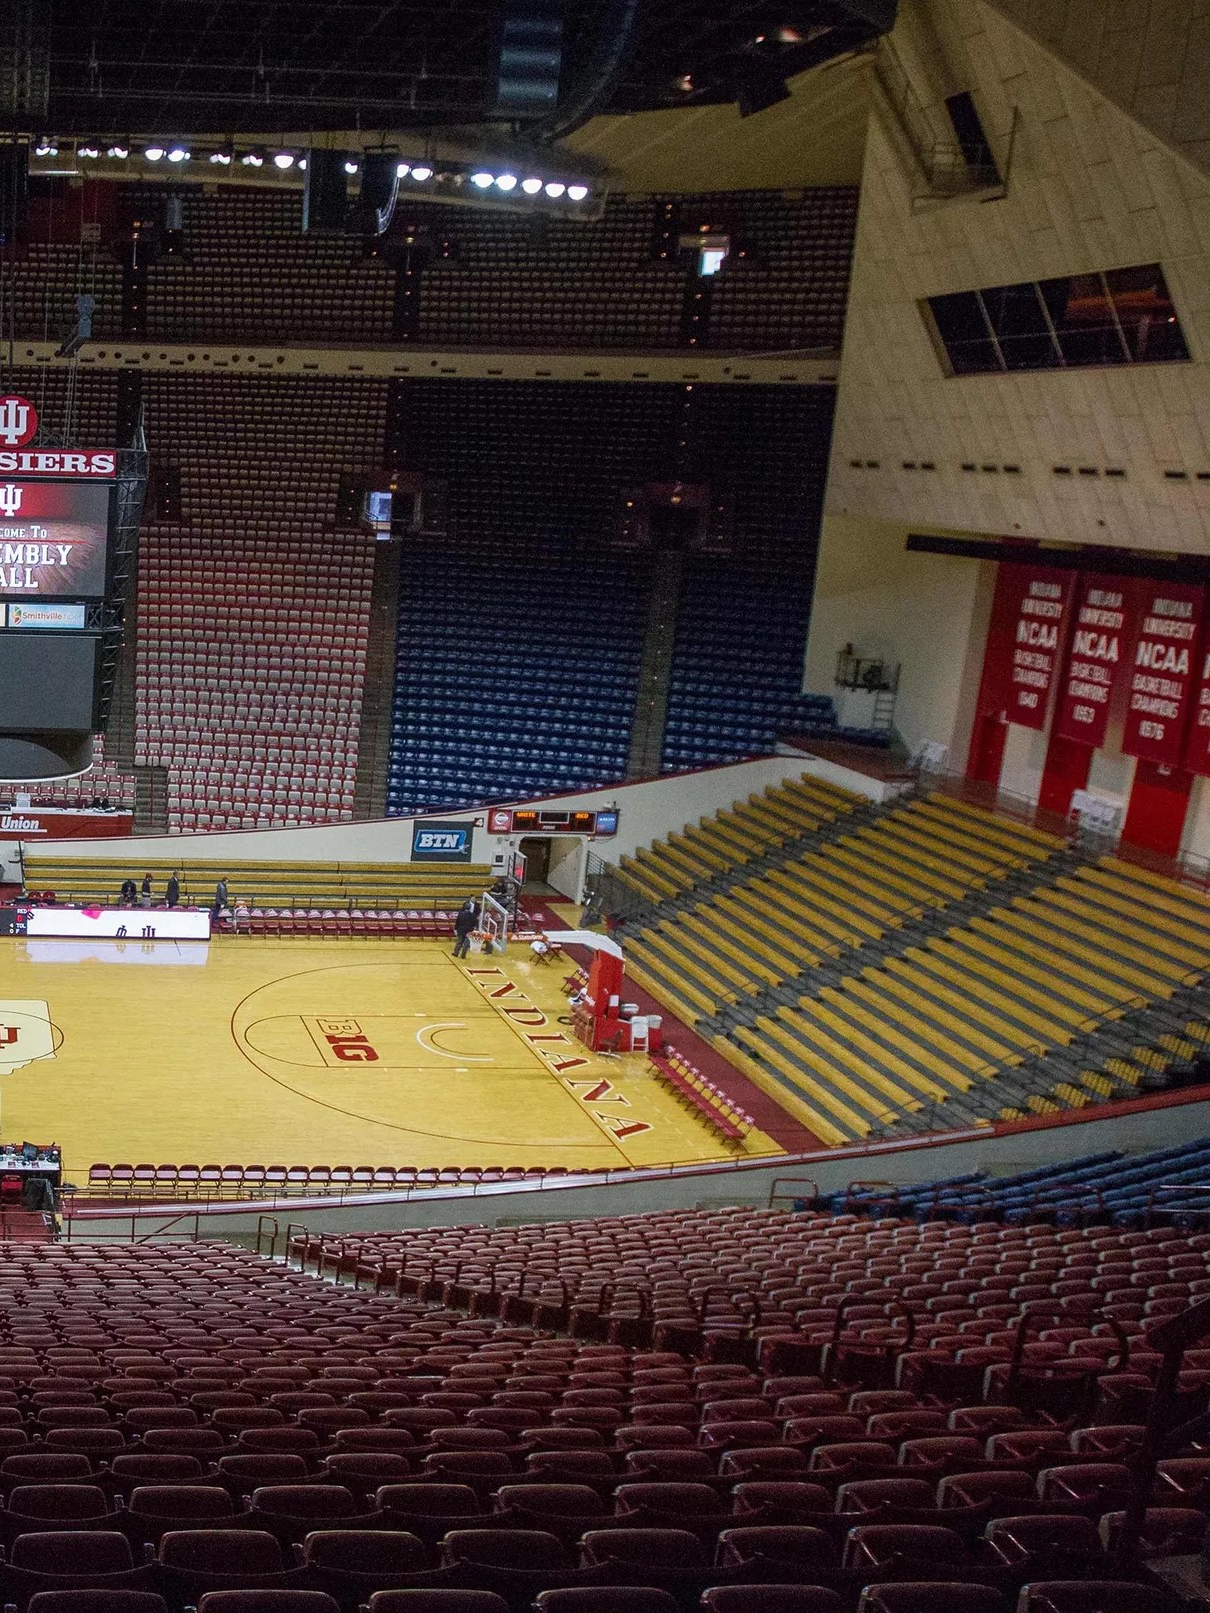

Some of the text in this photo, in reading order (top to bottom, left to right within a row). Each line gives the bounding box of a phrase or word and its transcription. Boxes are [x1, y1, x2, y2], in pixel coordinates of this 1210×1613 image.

[23, 611, 63, 620] Smithville
[1017, 620, 1057, 649] NCAA
[1073, 630, 1119, 662] NCAA
[1136, 641, 1189, 675] NCAA
[1, 816, 39, 829] Union
[419, 834, 459, 848] BTN
[465, 966, 654, 1142] INDIANA
